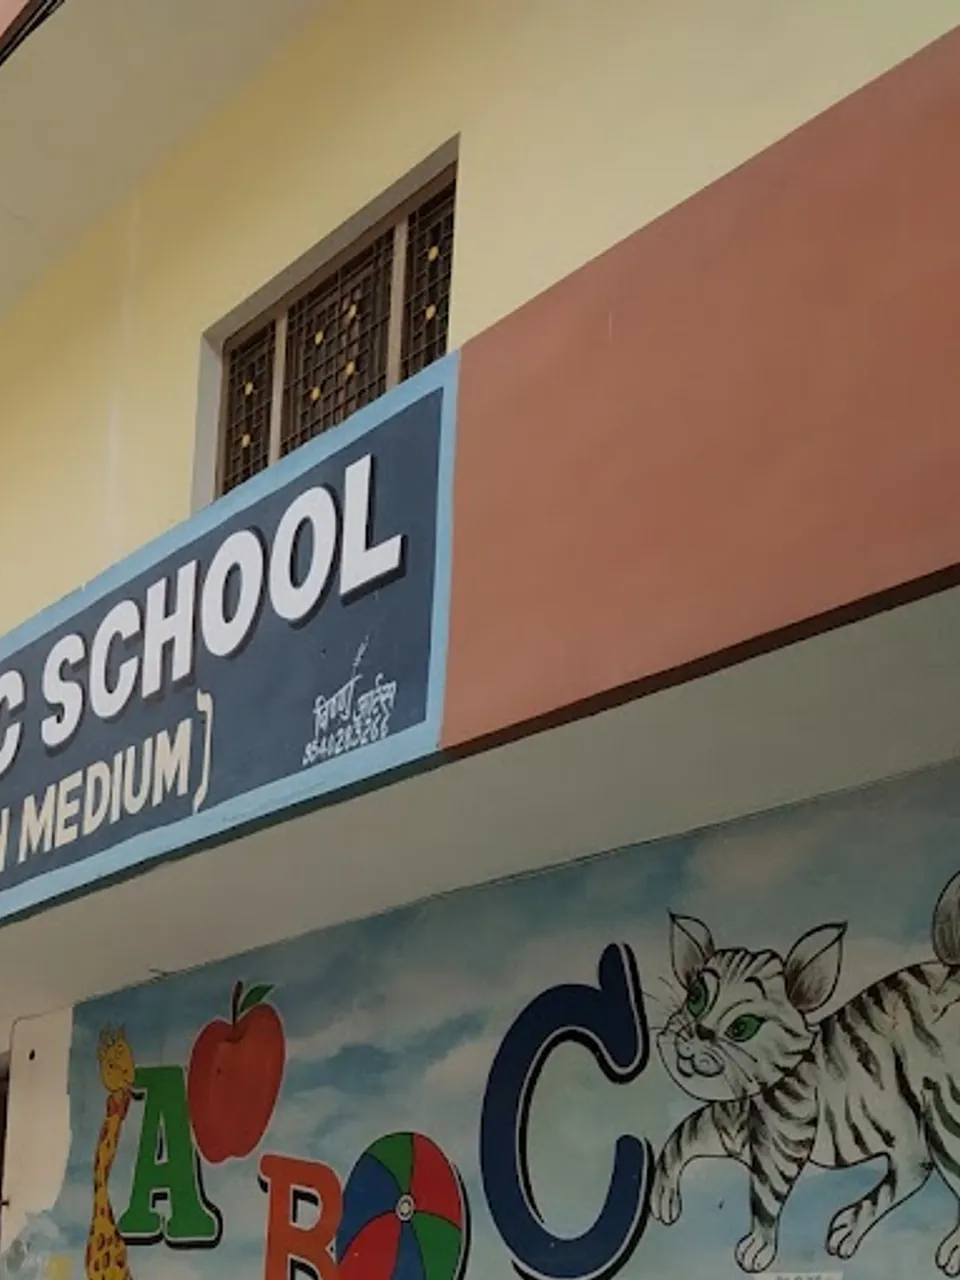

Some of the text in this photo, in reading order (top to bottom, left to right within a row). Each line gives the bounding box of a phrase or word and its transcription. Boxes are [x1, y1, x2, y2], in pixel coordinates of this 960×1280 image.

[41, 453, 404, 749] SCHOOL
[17, 688, 214, 863] MEDIUM)
[117, 1064, 222, 1250] A
